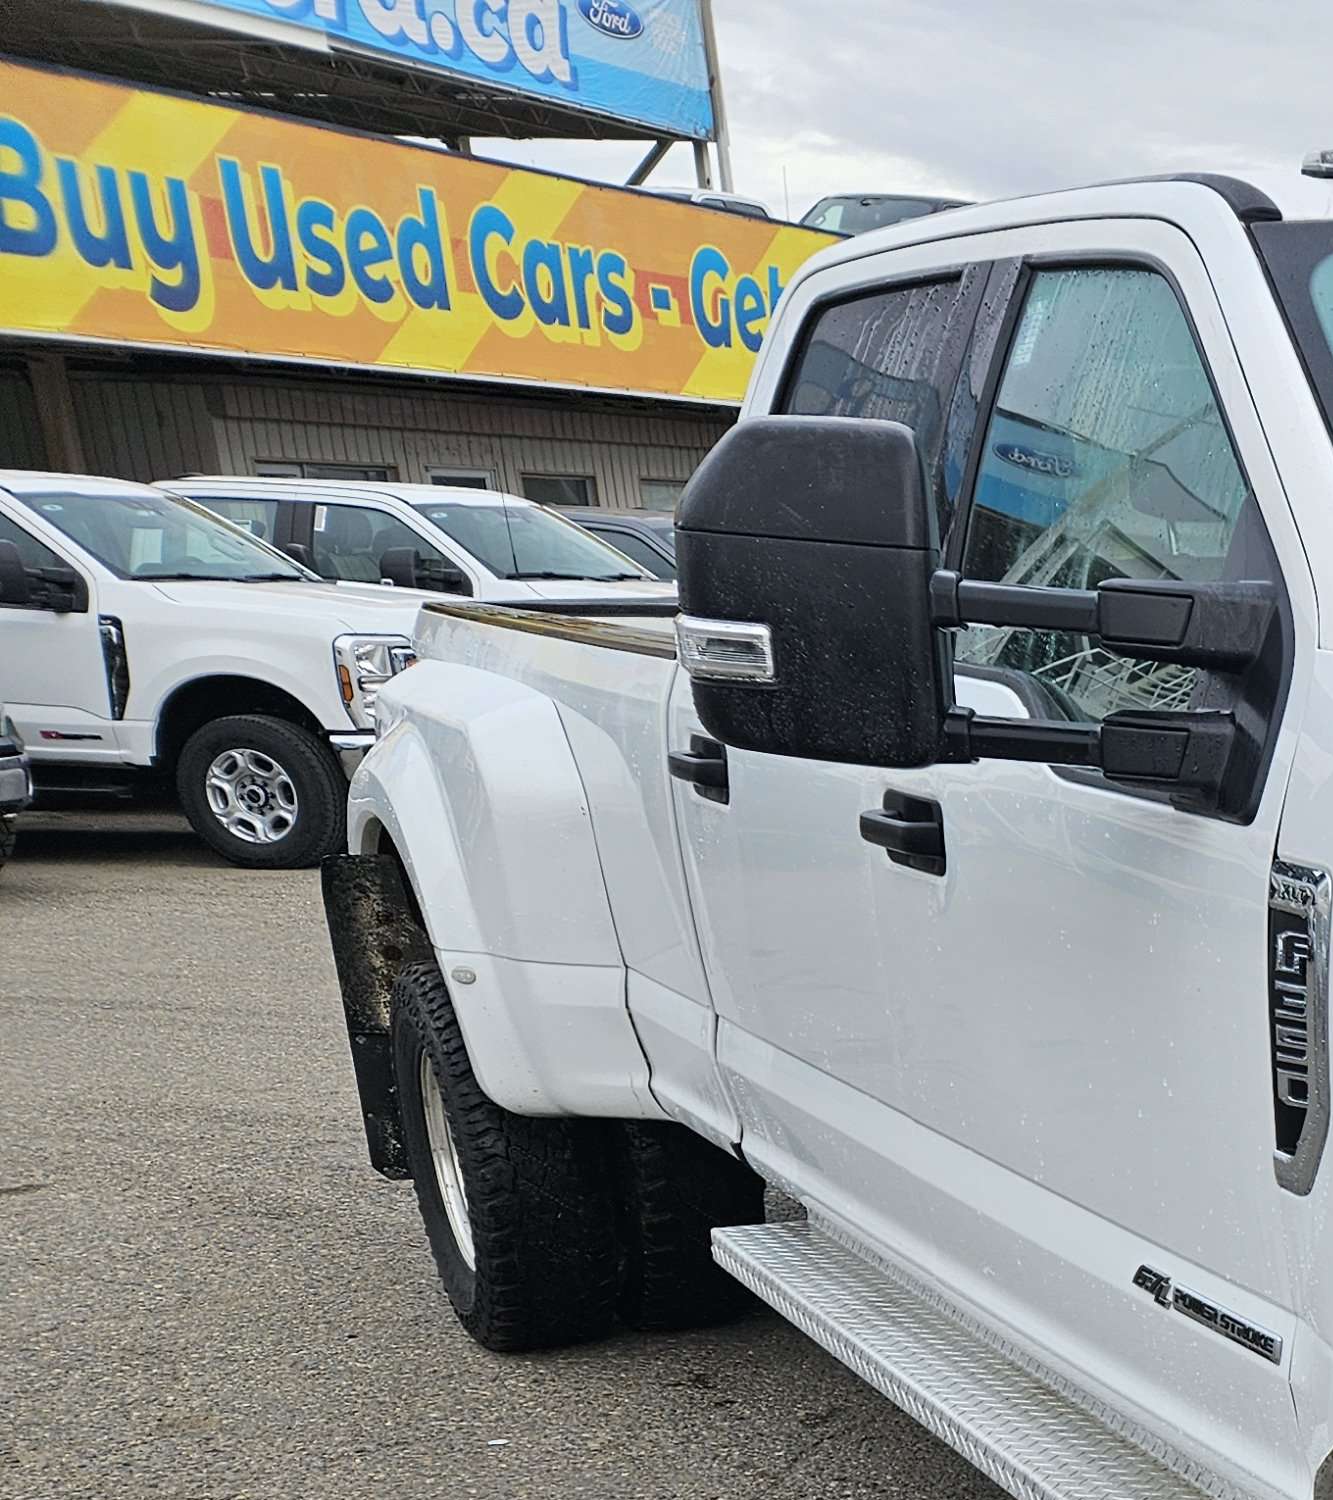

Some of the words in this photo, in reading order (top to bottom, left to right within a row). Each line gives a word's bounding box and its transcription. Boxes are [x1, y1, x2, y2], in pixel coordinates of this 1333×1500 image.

[0, 116, 201, 313] Buy
[217, 156, 451, 311] Used
[469, 205, 636, 335] Cars
